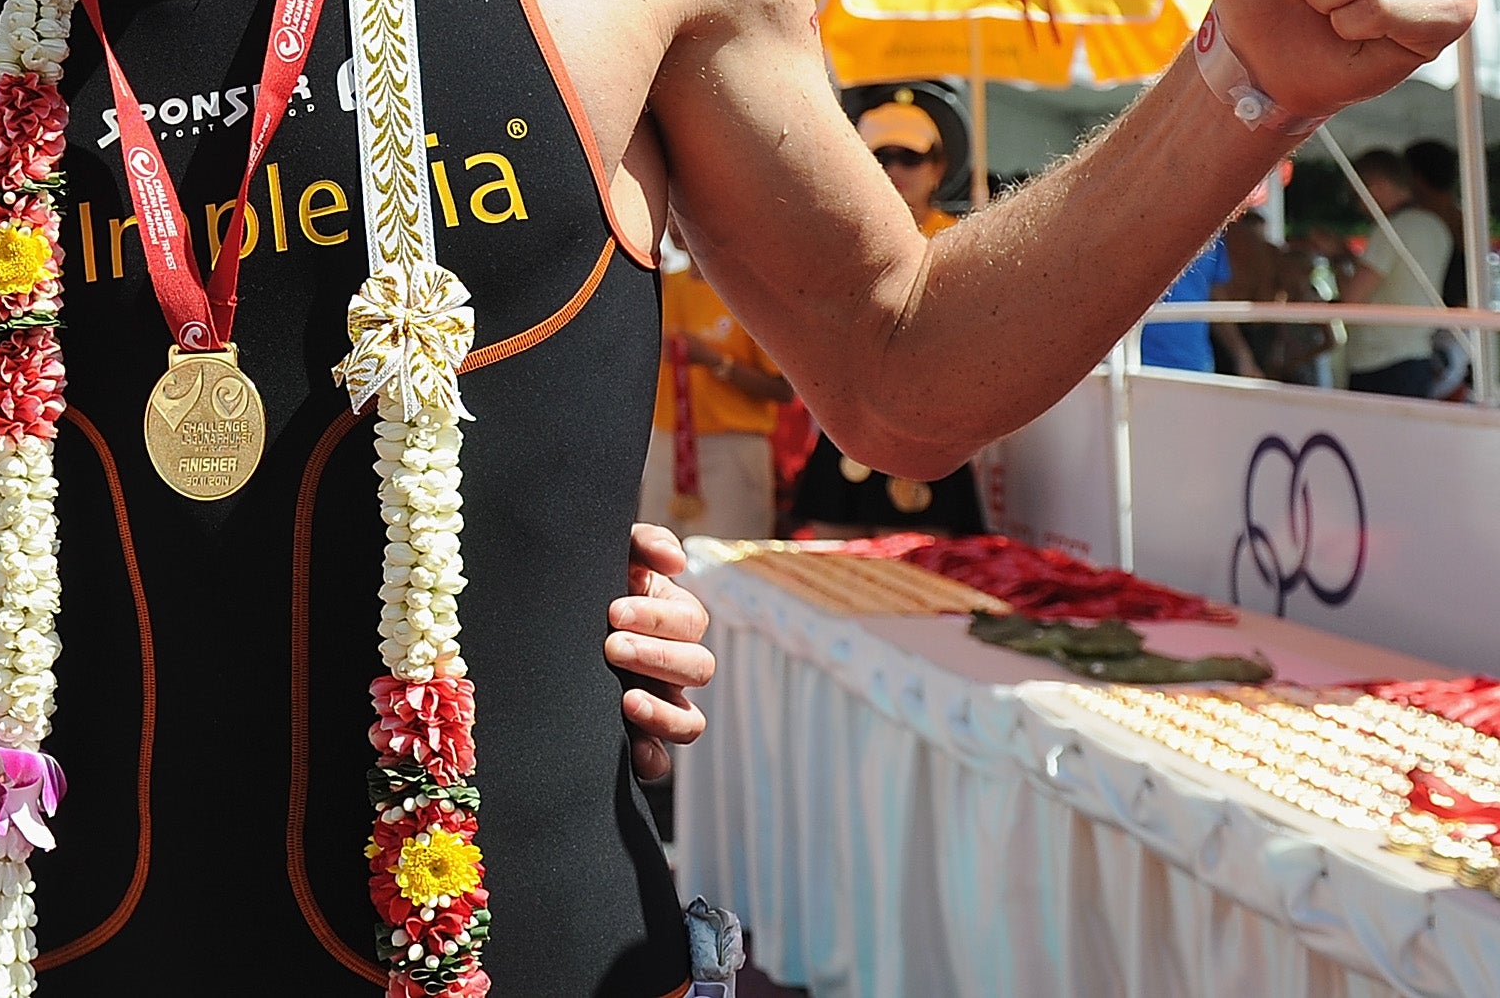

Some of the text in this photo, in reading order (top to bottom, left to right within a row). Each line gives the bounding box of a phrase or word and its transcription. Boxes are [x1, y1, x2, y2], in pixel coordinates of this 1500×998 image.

[97, 74, 312, 149] SPONSR
[160, 123, 215, 141] PORT
[182, 420, 249, 432] CHALLENGE
[178, 456, 238, 473] FINISHER
